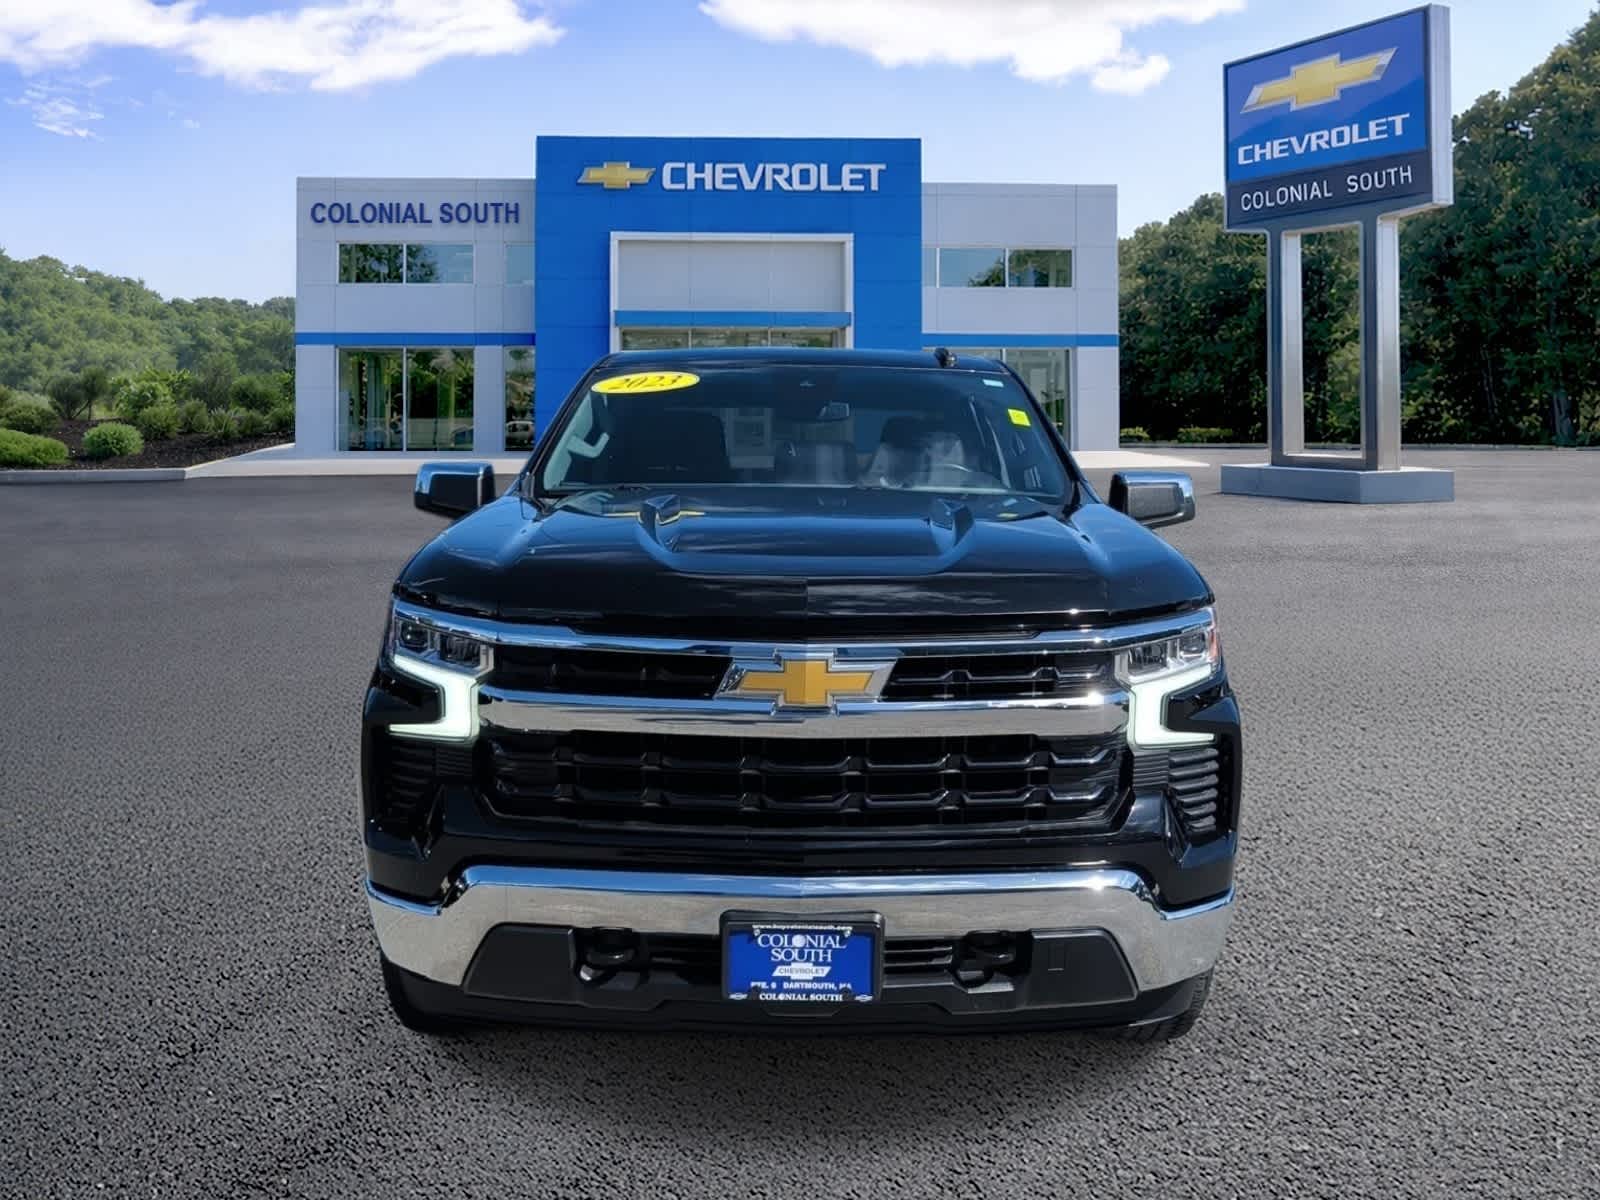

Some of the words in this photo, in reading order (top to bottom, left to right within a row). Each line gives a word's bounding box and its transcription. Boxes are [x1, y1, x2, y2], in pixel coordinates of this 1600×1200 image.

[1237, 112, 1410, 165] CHEVROLET
[661, 161, 887, 192] CHEVROLET
[1240, 180, 1333, 211] COLONIAL
[1346, 165, 1413, 193] SOUTH
[310, 202, 433, 224] COLONIAL
[439, 202, 520, 224] SOUTH
[607, 375, 683, 391] 2023
[757, 933, 847, 949] COLONIAL
[771, 949, 832, 962] SOUTH
[778, 967, 825, 975] CHEVROLET
[783, 982, 838, 991] DARTMOUTH,
[759, 993, 808, 1001] COLONIAL
[809, 993, 843, 1002] SOUTH
